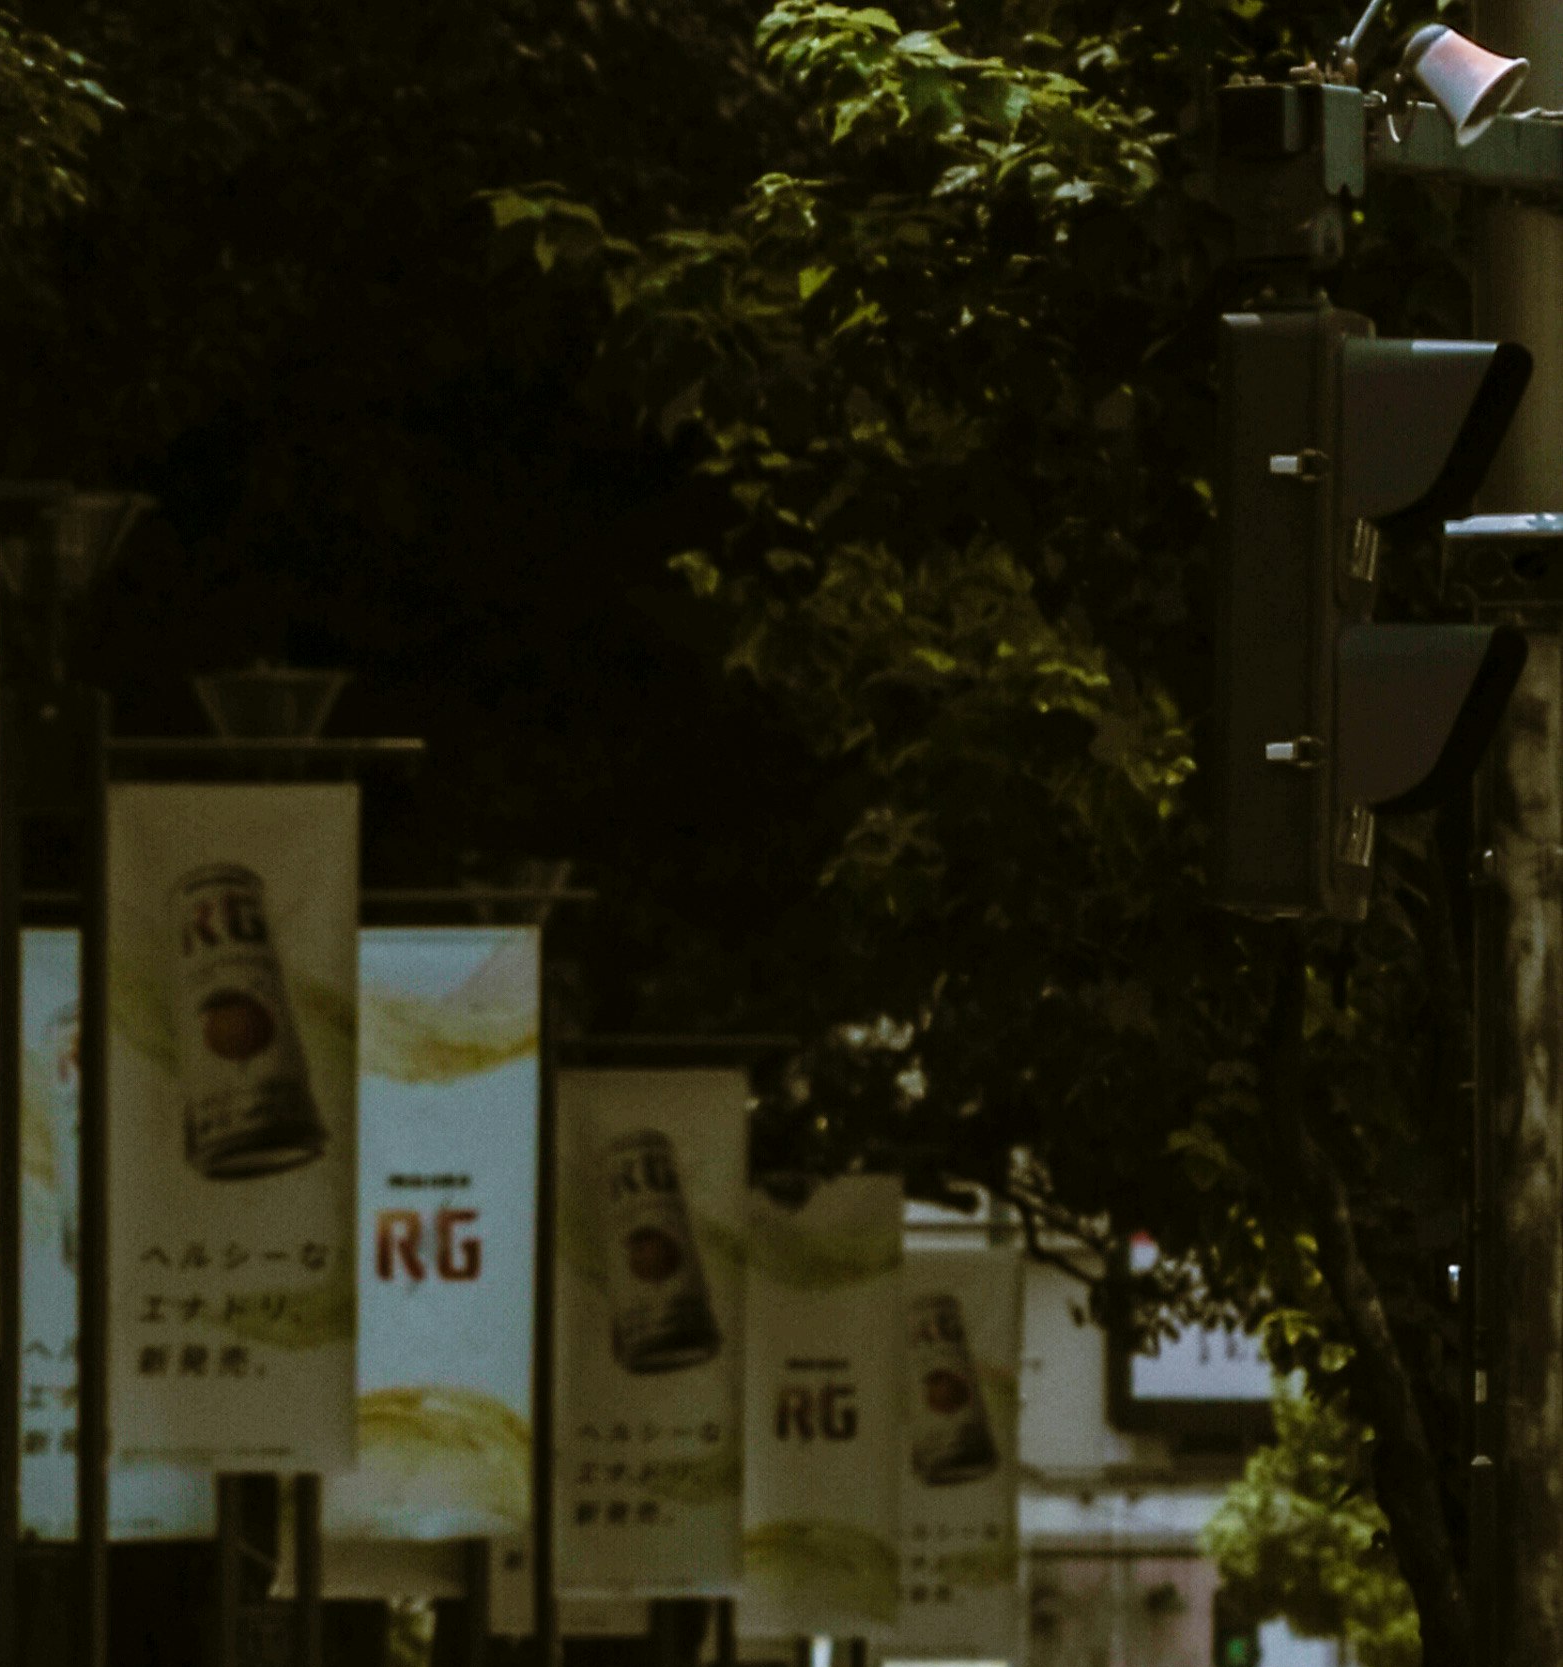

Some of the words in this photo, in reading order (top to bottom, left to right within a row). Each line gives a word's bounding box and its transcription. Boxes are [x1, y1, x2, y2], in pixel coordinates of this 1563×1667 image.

[140, 1241, 329, 1272] ヘルシーな
[376, 1209, 482, 1282] RG
[776, 1384, 858, 1441] RG
